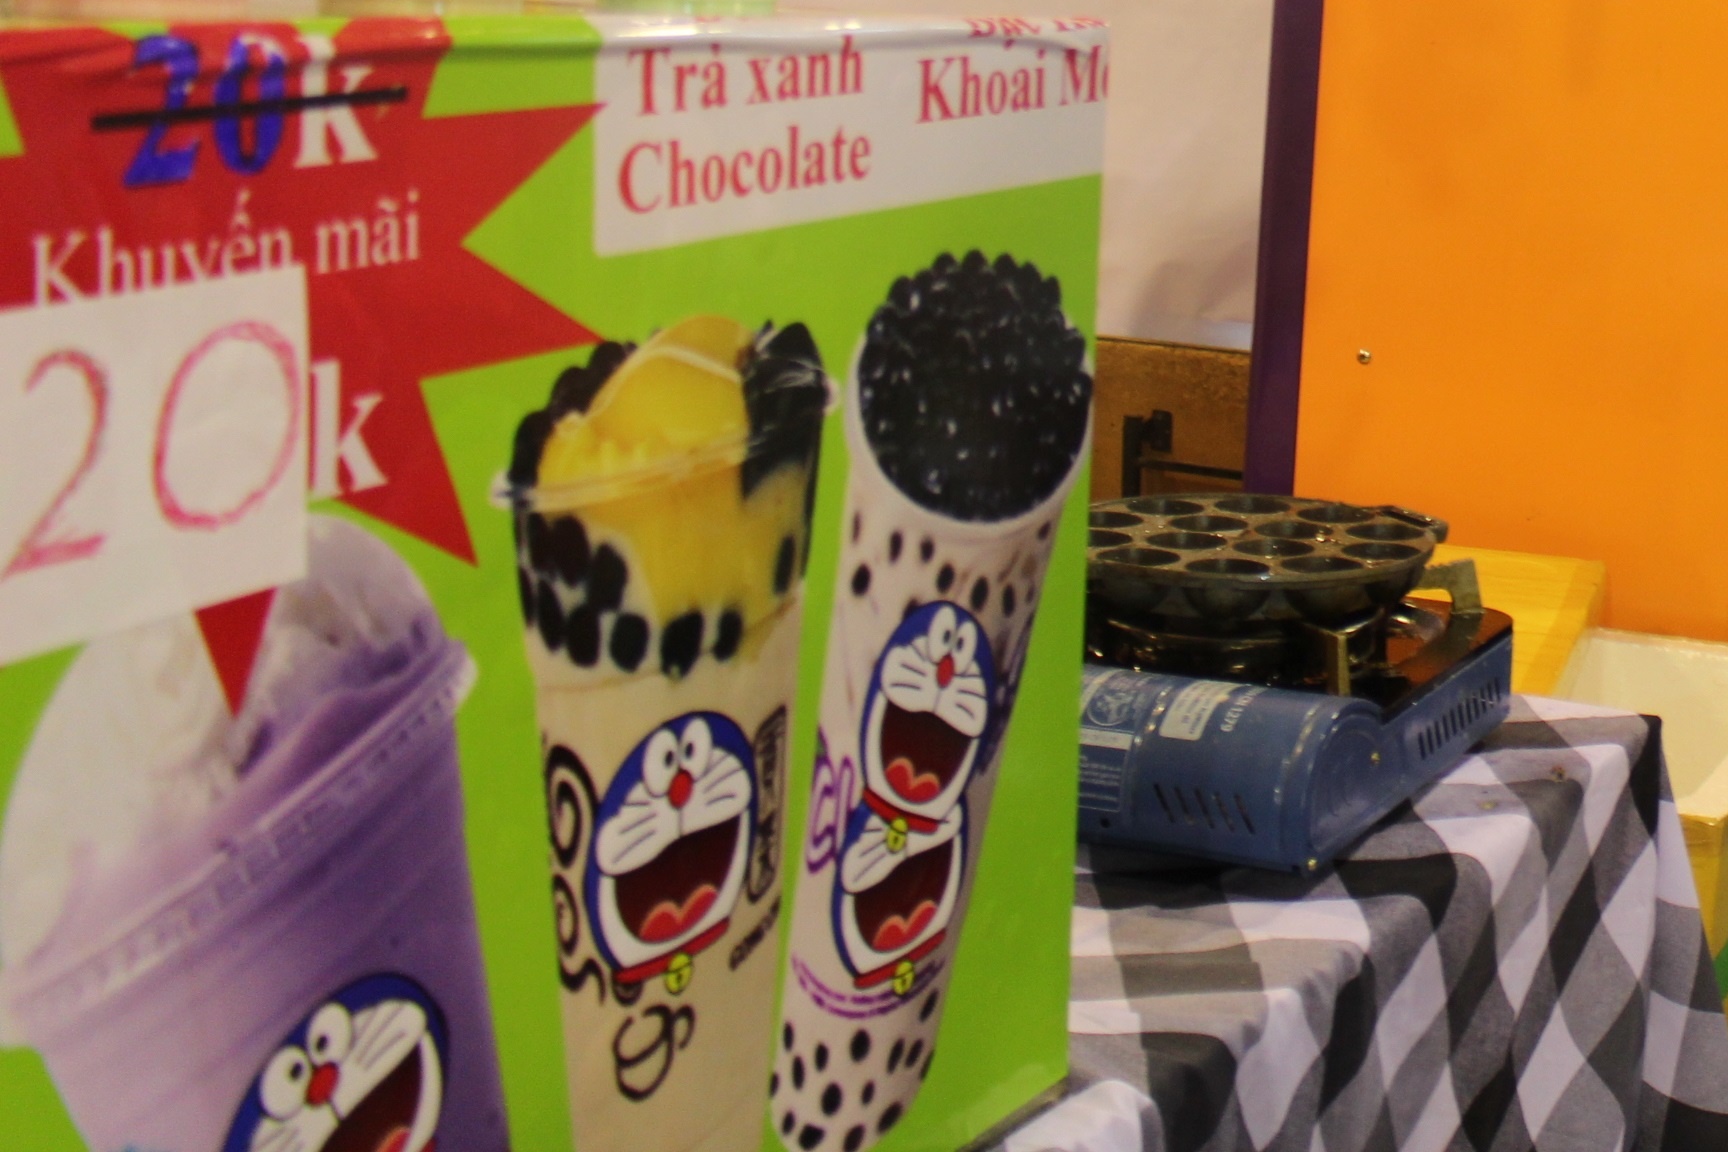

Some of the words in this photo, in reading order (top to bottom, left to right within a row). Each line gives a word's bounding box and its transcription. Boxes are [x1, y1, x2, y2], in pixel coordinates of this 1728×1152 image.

[745, 34, 863, 106] xanh
[916, 48, 1046, 124] Khoai
[617, 124, 872, 215] Chocolate
